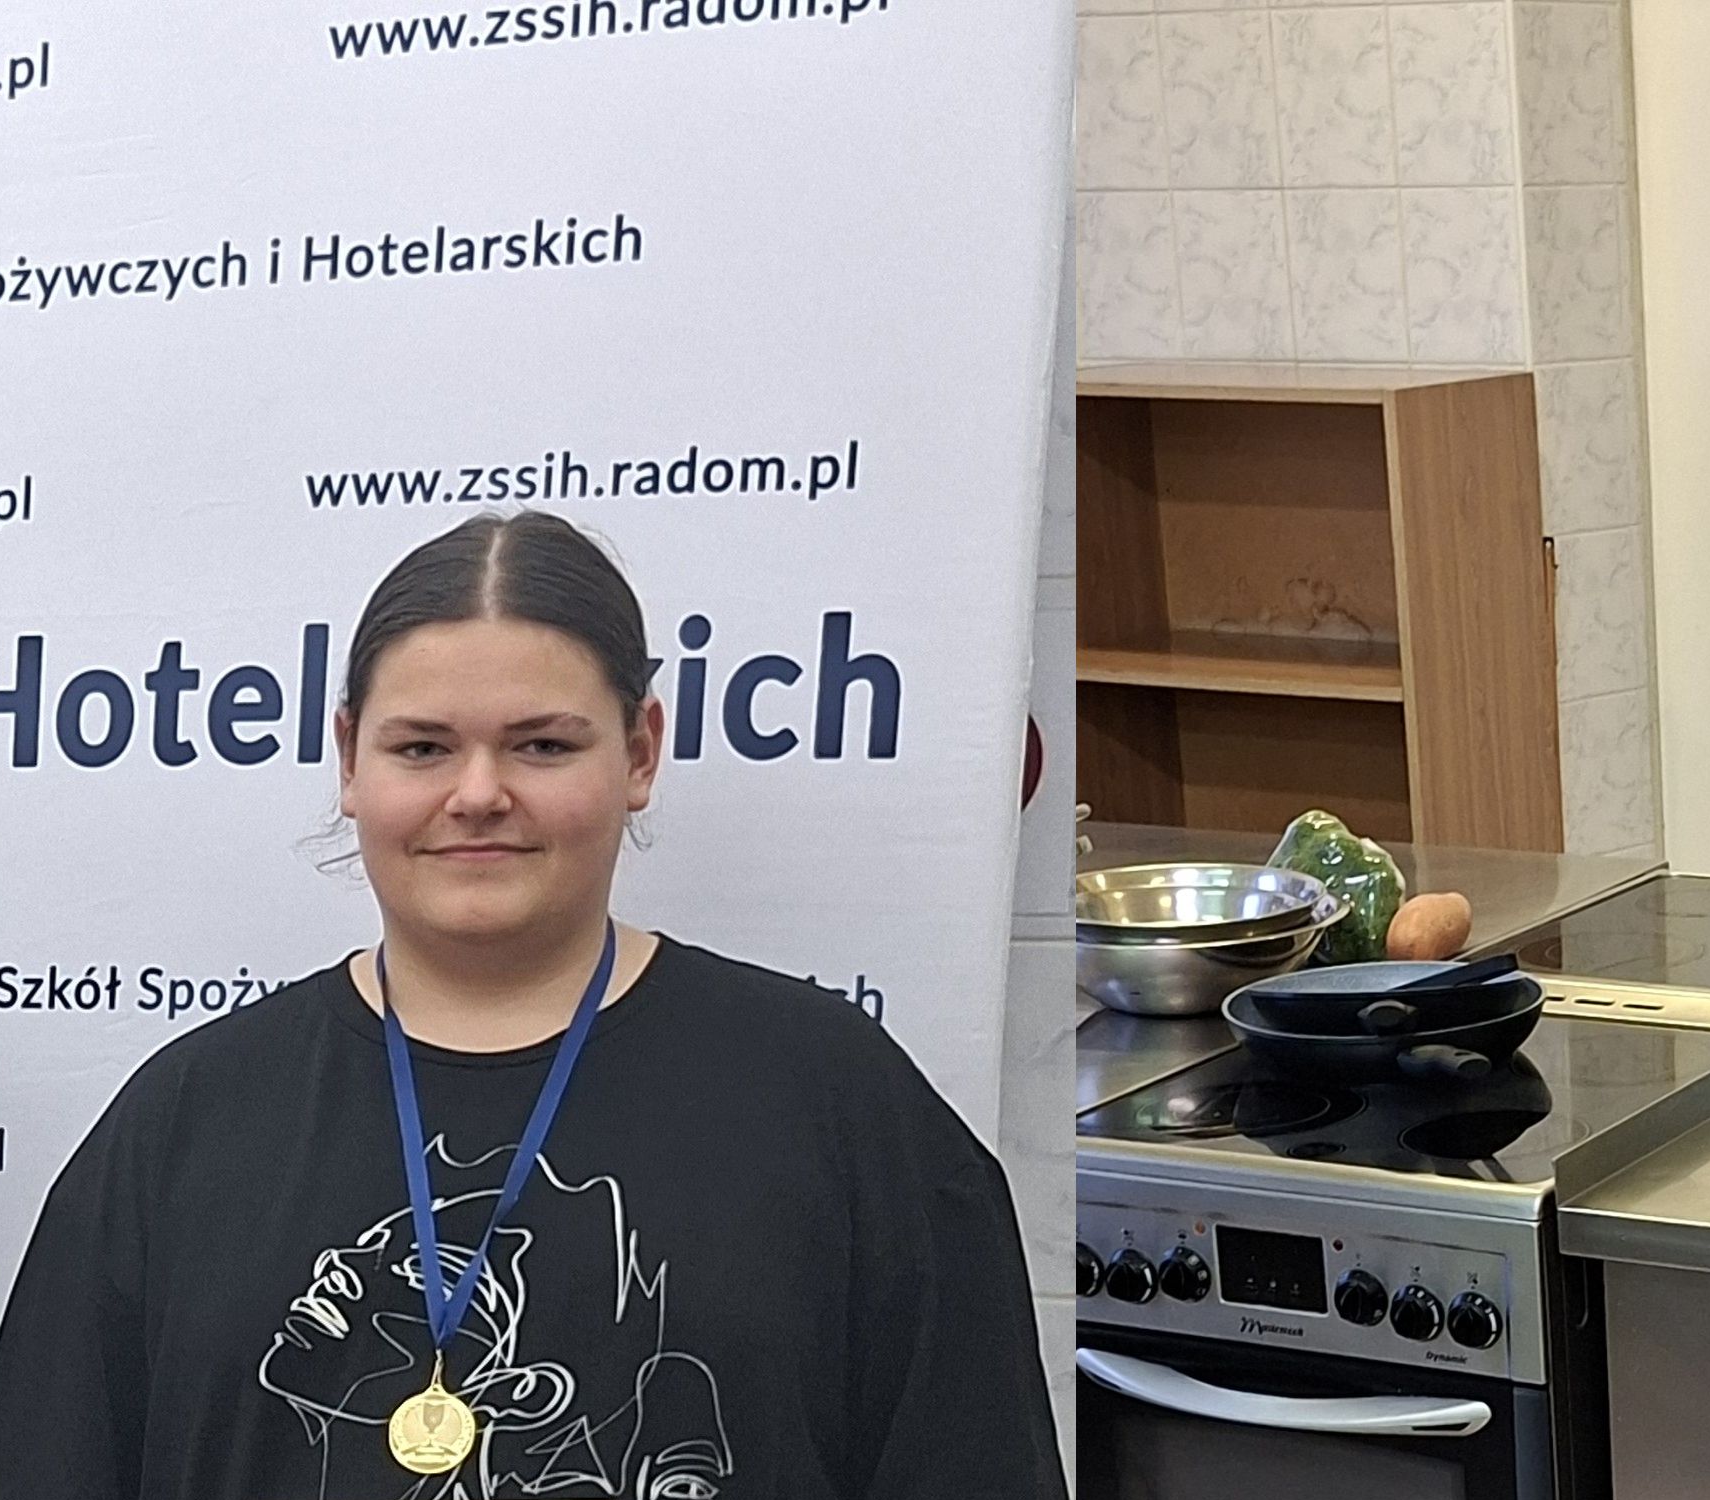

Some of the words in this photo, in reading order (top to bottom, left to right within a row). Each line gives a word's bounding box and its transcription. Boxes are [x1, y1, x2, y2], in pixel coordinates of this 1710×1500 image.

[270, 238, 281, 284] i
[303, 214, 642, 282] Hotelarskich
[306, 440, 858, 508] www.zssih.radom.pl
